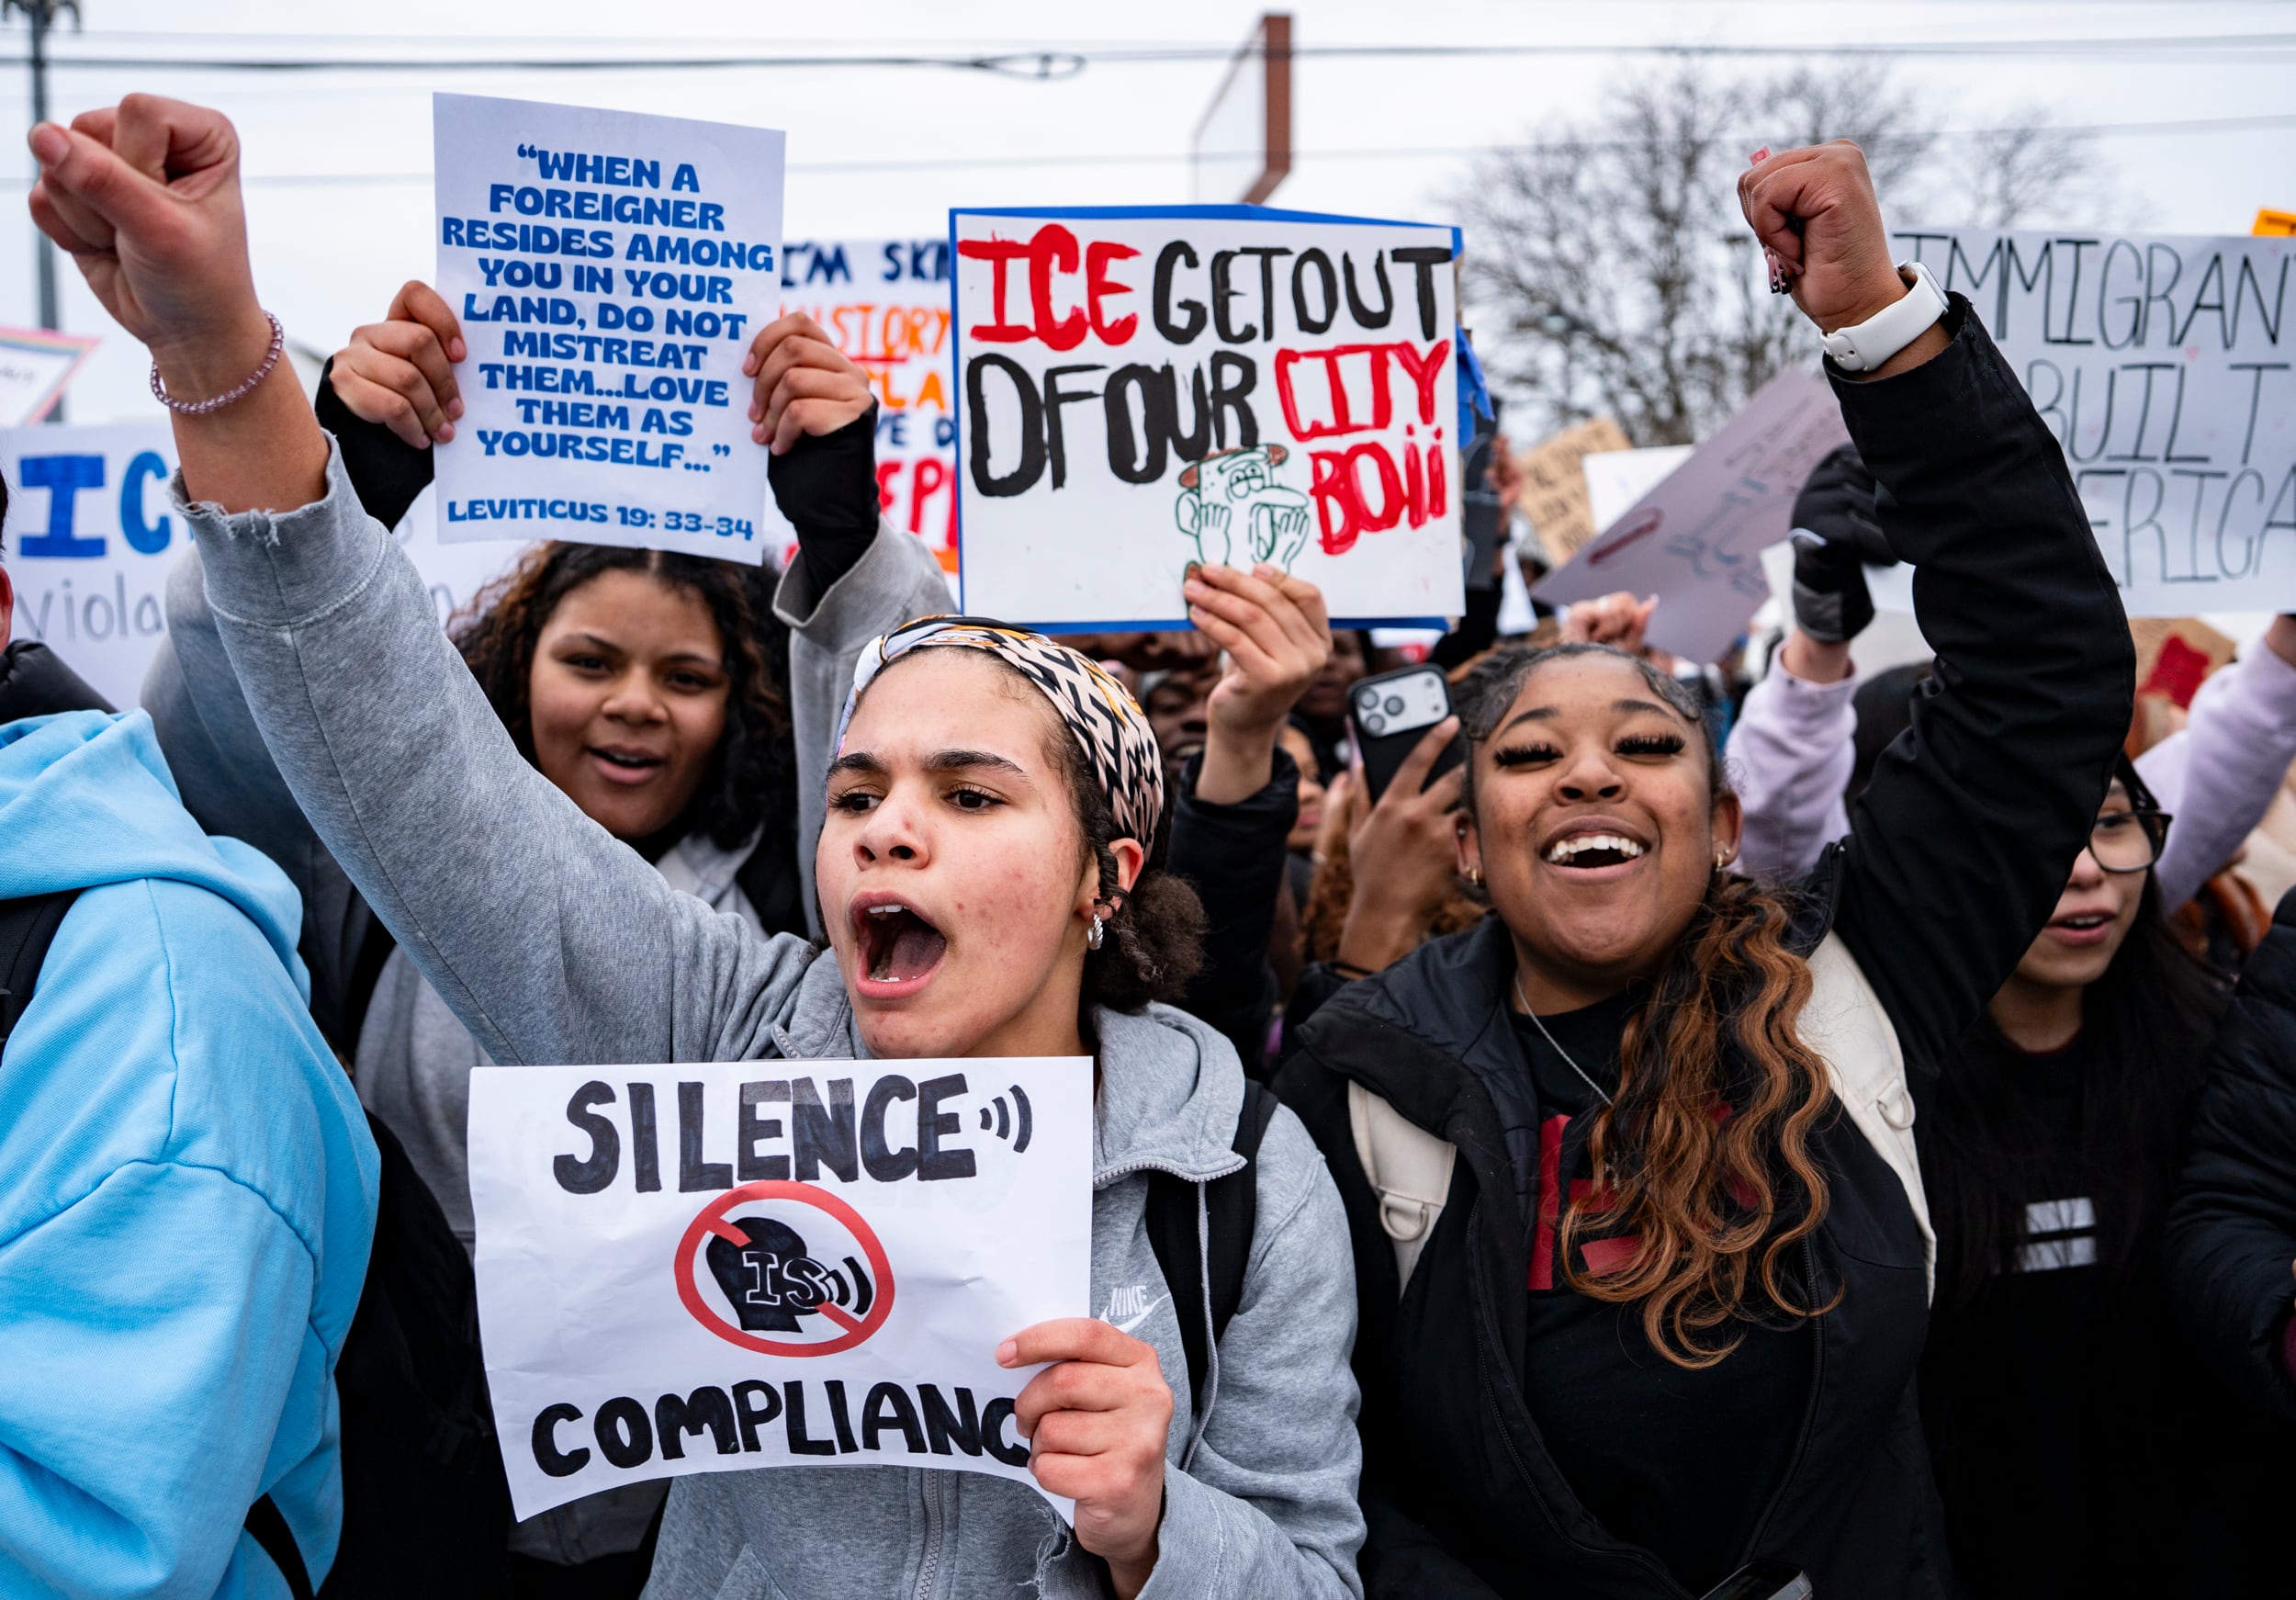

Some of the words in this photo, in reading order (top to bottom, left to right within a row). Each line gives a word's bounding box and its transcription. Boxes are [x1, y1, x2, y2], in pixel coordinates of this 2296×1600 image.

[670, 163, 701, 194] A
[489, 183, 726, 232] FOREIGNER
[442, 216, 615, 259] RESIDES
[625, 232, 774, 273] AMONG
[478, 257, 563, 290] YOU
[572, 264, 614, 295] IN
[624, 268, 734, 305] YOUR
[957, 223, 1142, 353] ICE
[1892, 233, 2296, 352] MMIGRAN
[463, 293, 588, 332] LAND,
[597, 301, 655, 333] DO
[665, 308, 748, 342] NOT
[780, 302, 951, 356] STORY
[503, 330, 709, 371] MISTREAT
[515, 398, 631, 432] THEM
[640, 408, 694, 438] AS
[1273, 338, 1451, 444] CITY
[2027, 359, 2291, 465] BUILT
[19, 450, 196, 558] IC
[447, 499, 610, 524] LEVITICUS
[616, 506, 658, 530] 19:
[664, 511, 754, 541] 33-34
[553, 1073, 976, 1195] SILENCE
[741, 1249, 830, 1310] IS
[1109, 1285, 1148, 1317] NIKE
[531, 1380, 1032, 1478] COMPLIANC
